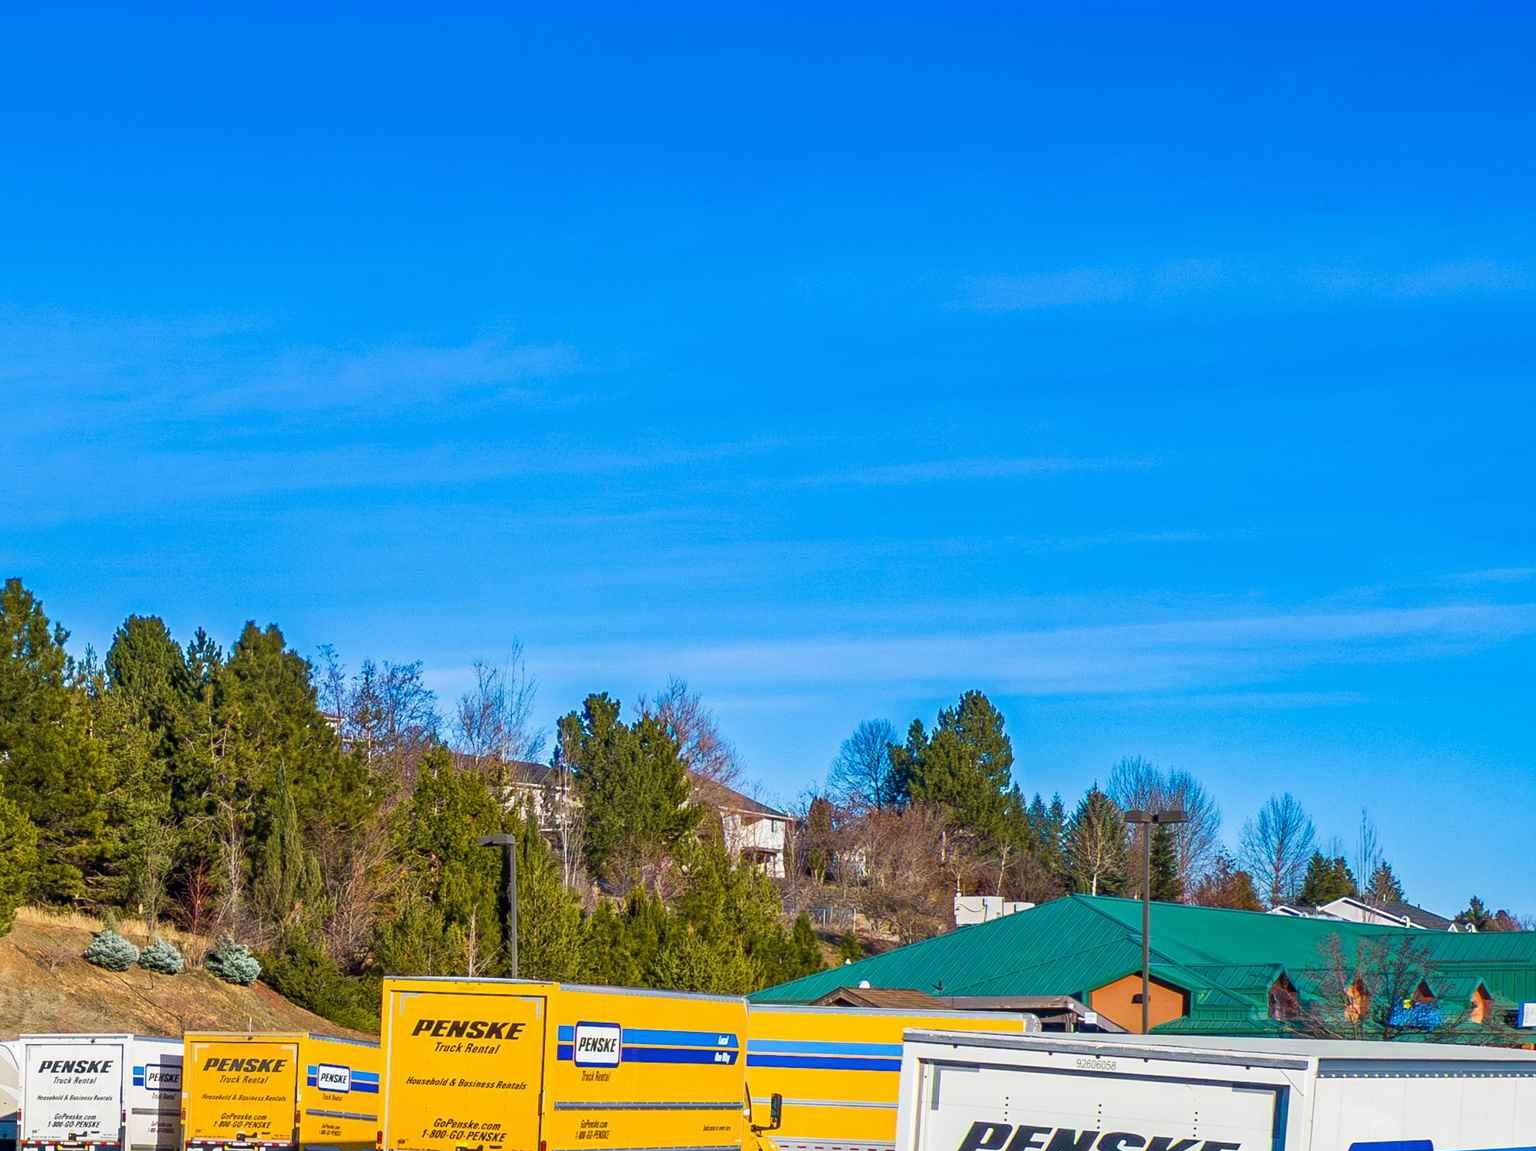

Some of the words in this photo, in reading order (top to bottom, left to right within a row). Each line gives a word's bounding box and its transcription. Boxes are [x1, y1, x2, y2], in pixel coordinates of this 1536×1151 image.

[411, 1018, 527, 1040] PENSKE
[433, 1041, 464, 1053] Truck
[464, 1042, 501, 1055] Rental
[578, 1037, 617, 1053] PENSKE
[38, 1060, 114, 1074] PENSKE
[203, 1057, 288, 1073] PENSKE
[52, 1076, 72, 1085] Truck
[74, 1076, 97, 1085] Rental
[148, 1072, 180, 1083] PENSKE
[219, 1075, 240, 1084] Truck
[242, 1075, 269, 1085] Rental
[320, 1072, 348, 1085] PENSKE
[406, 1076, 450, 1087] Household
[449, 1078, 457, 1087] &
[457, 1078, 496, 1089] Business
[495, 1080, 528, 1090] Rentals
[53, 1112, 97, 1121] GoPenske.com
[220, 1112, 268, 1121] GoPenske.com
[433, 1117, 501, 1131] GoPenske.com
[421, 1128, 508, 1143] 1-800-GO-PENSKE
